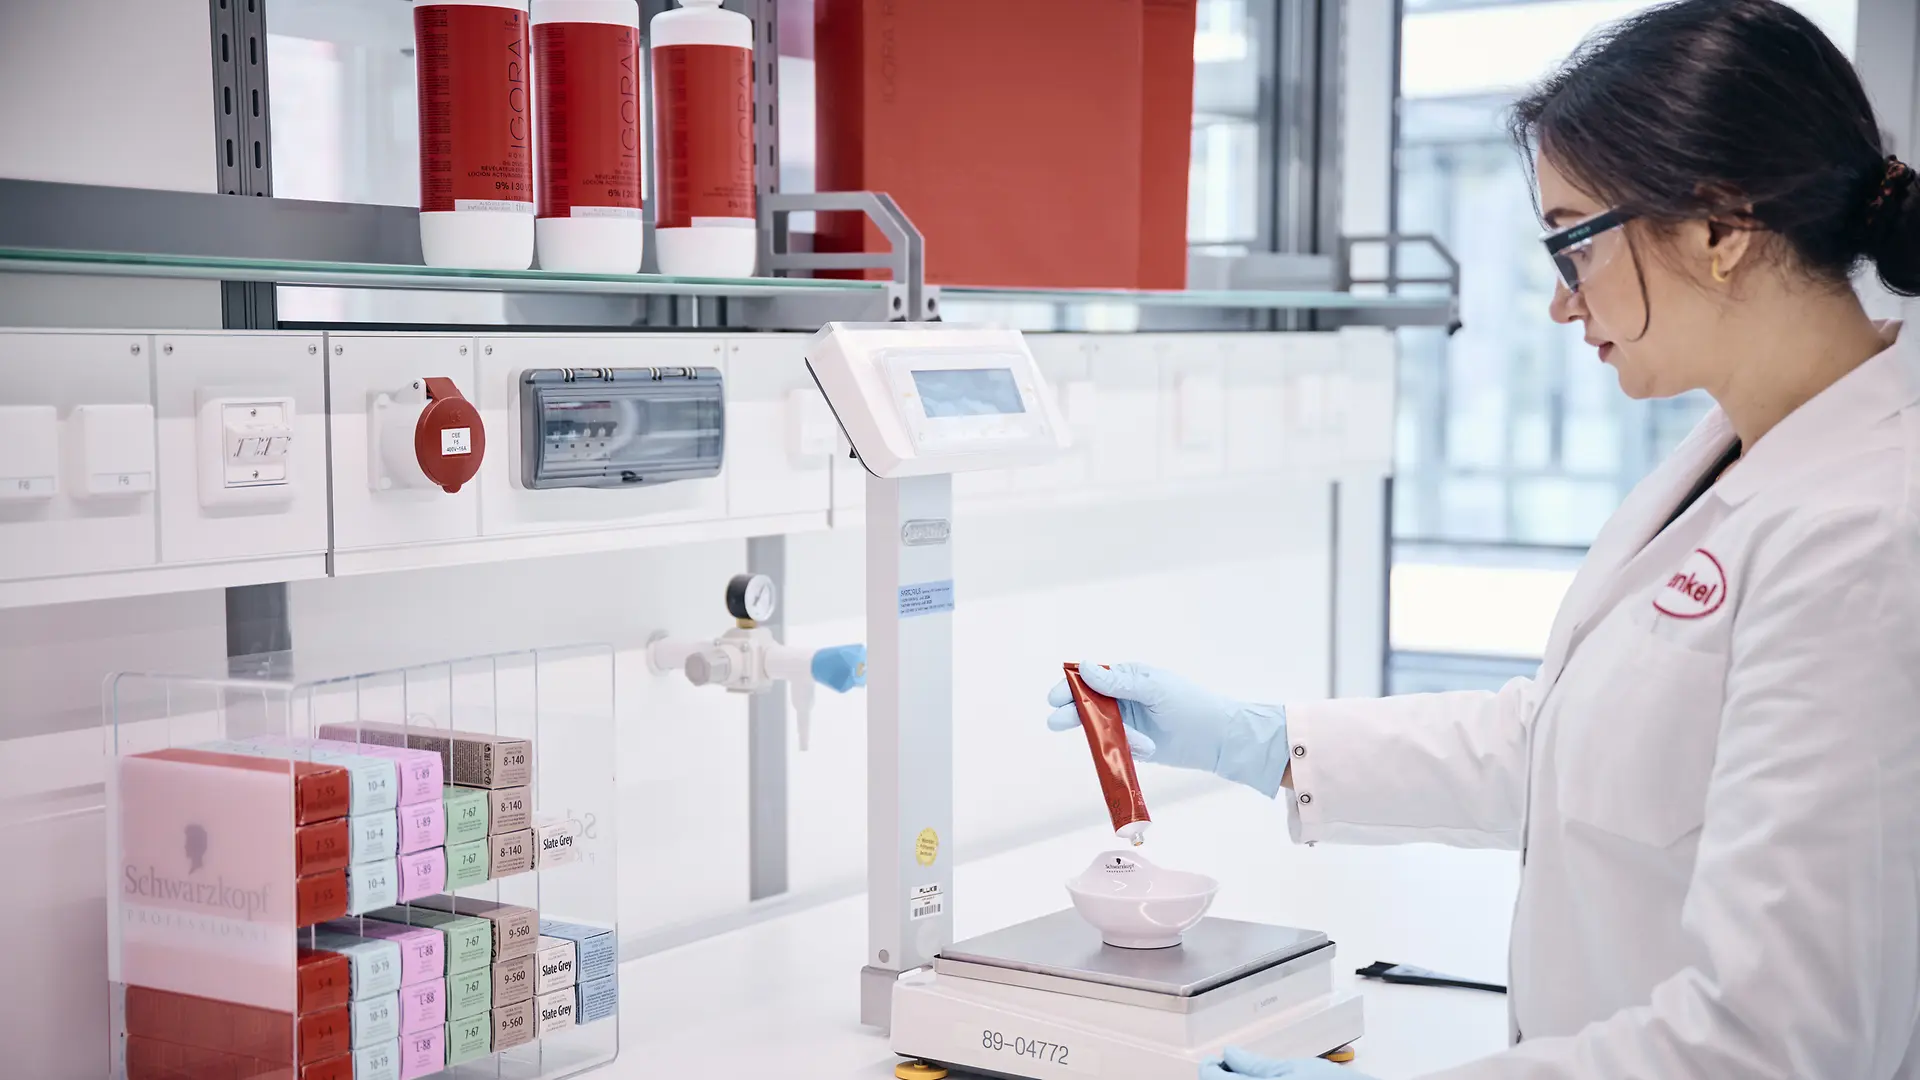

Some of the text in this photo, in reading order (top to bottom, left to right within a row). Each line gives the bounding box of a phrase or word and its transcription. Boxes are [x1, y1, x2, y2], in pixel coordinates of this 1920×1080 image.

[508, 39, 526, 149] IGORA
[620, 53, 637, 158] IGORA
[495, 181, 510, 190] 9%
[608, 189, 621, 198] 6%
[1666, 572, 1718, 605] nkel
[503, 755, 525, 766] 8-140
[415, 766, 430, 780] L-89
[368, 780, 386, 792] 10-4
[462, 807, 477, 819] 7-67
[500, 800, 523, 812] 8-140
[416, 816, 431, 829] L-89
[366, 828, 384, 841] 10-4
[543, 834, 573, 851] Slate Grey
[500, 844, 523, 858] 8-140
[462, 853, 477, 865] 7-67
[417, 863, 432, 876] L-89
[368, 877, 386, 890] 10-4
[125, 864, 275, 922] Schwarzkopf
[508, 923, 530, 939] 9-560
[465, 935, 480, 948] 7-67
[542, 960, 572, 977] Slate Grey
[504, 970, 526, 985] 9-560
[465, 980, 480, 994] 7-67
[542, 1004, 572, 1022] Slate Grey
[502, 1016, 524, 1031] 9-560
[464, 1026, 479, 1040] 7-67
